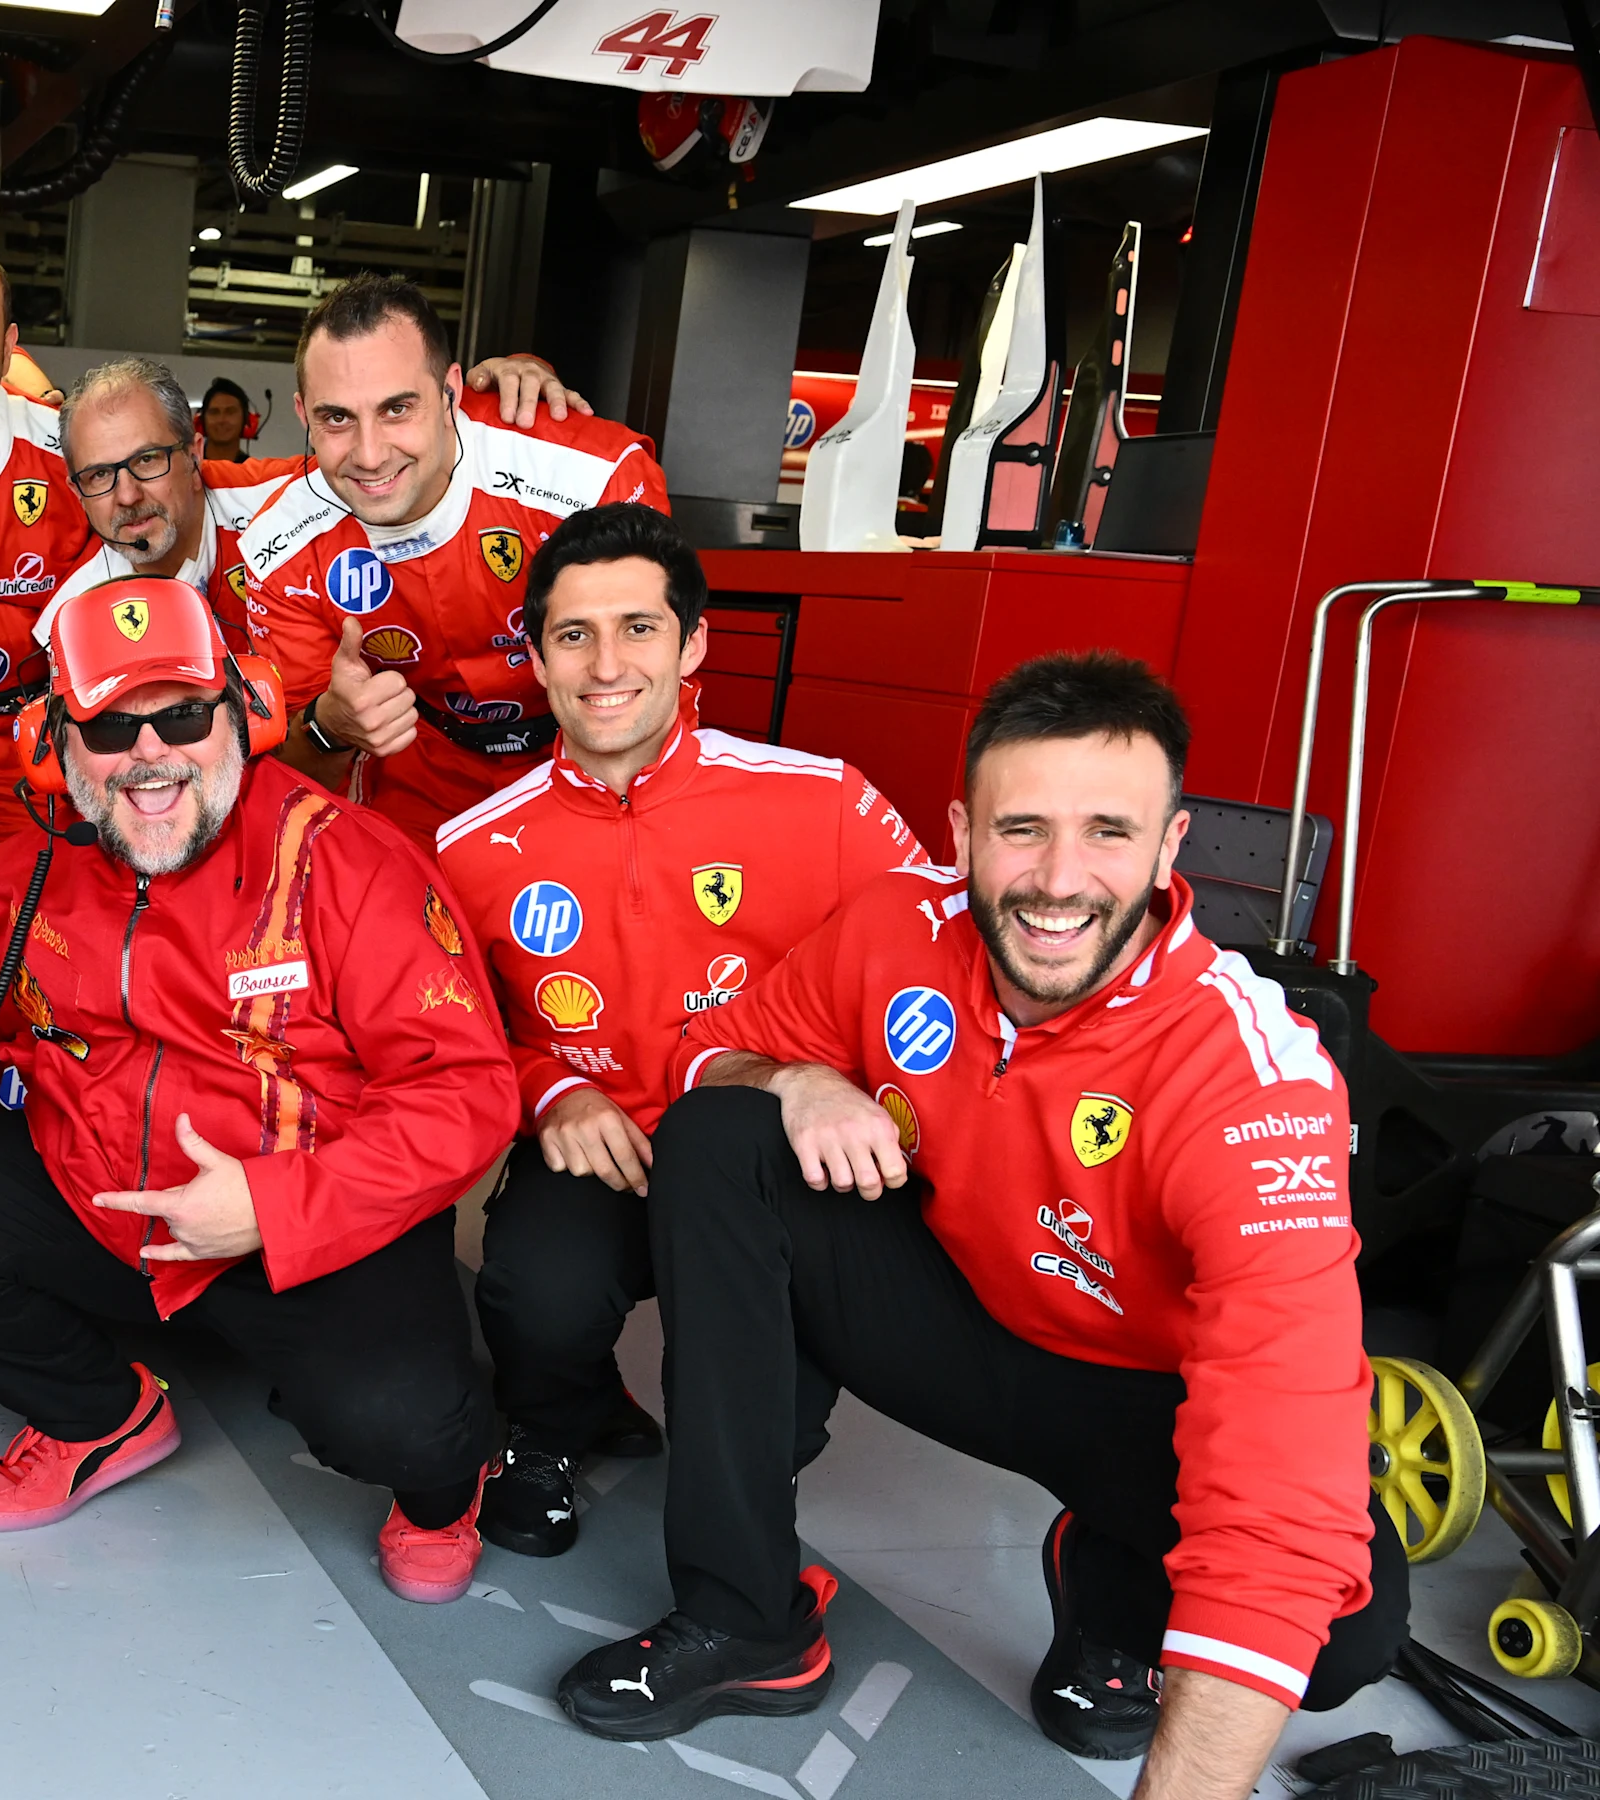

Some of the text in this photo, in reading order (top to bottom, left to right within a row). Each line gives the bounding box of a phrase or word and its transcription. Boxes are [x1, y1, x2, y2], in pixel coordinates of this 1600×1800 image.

[594, 10, 717, 77] 44
[525, 485, 588, 511] TECHNOLOGY
[254, 533, 288, 570] DXC
[284, 507, 332, 540] TECHNOLOGY
[379, 531, 436, 562] IBM
[339, 549, 383, 613] hp
[485, 741, 523, 754] PUMA
[521, 882, 573, 955] hp
[232, 974, 300, 995] Bowser
[888, 990, 952, 1070] hp
[1251, 1155, 1336, 1194] DXC
[1258, 1192, 1337, 1206] TECHNOLOGY
[1039, 1207, 1113, 1276] UniCredit
[1240, 1216, 1349, 1236] RICHARD MILLE
